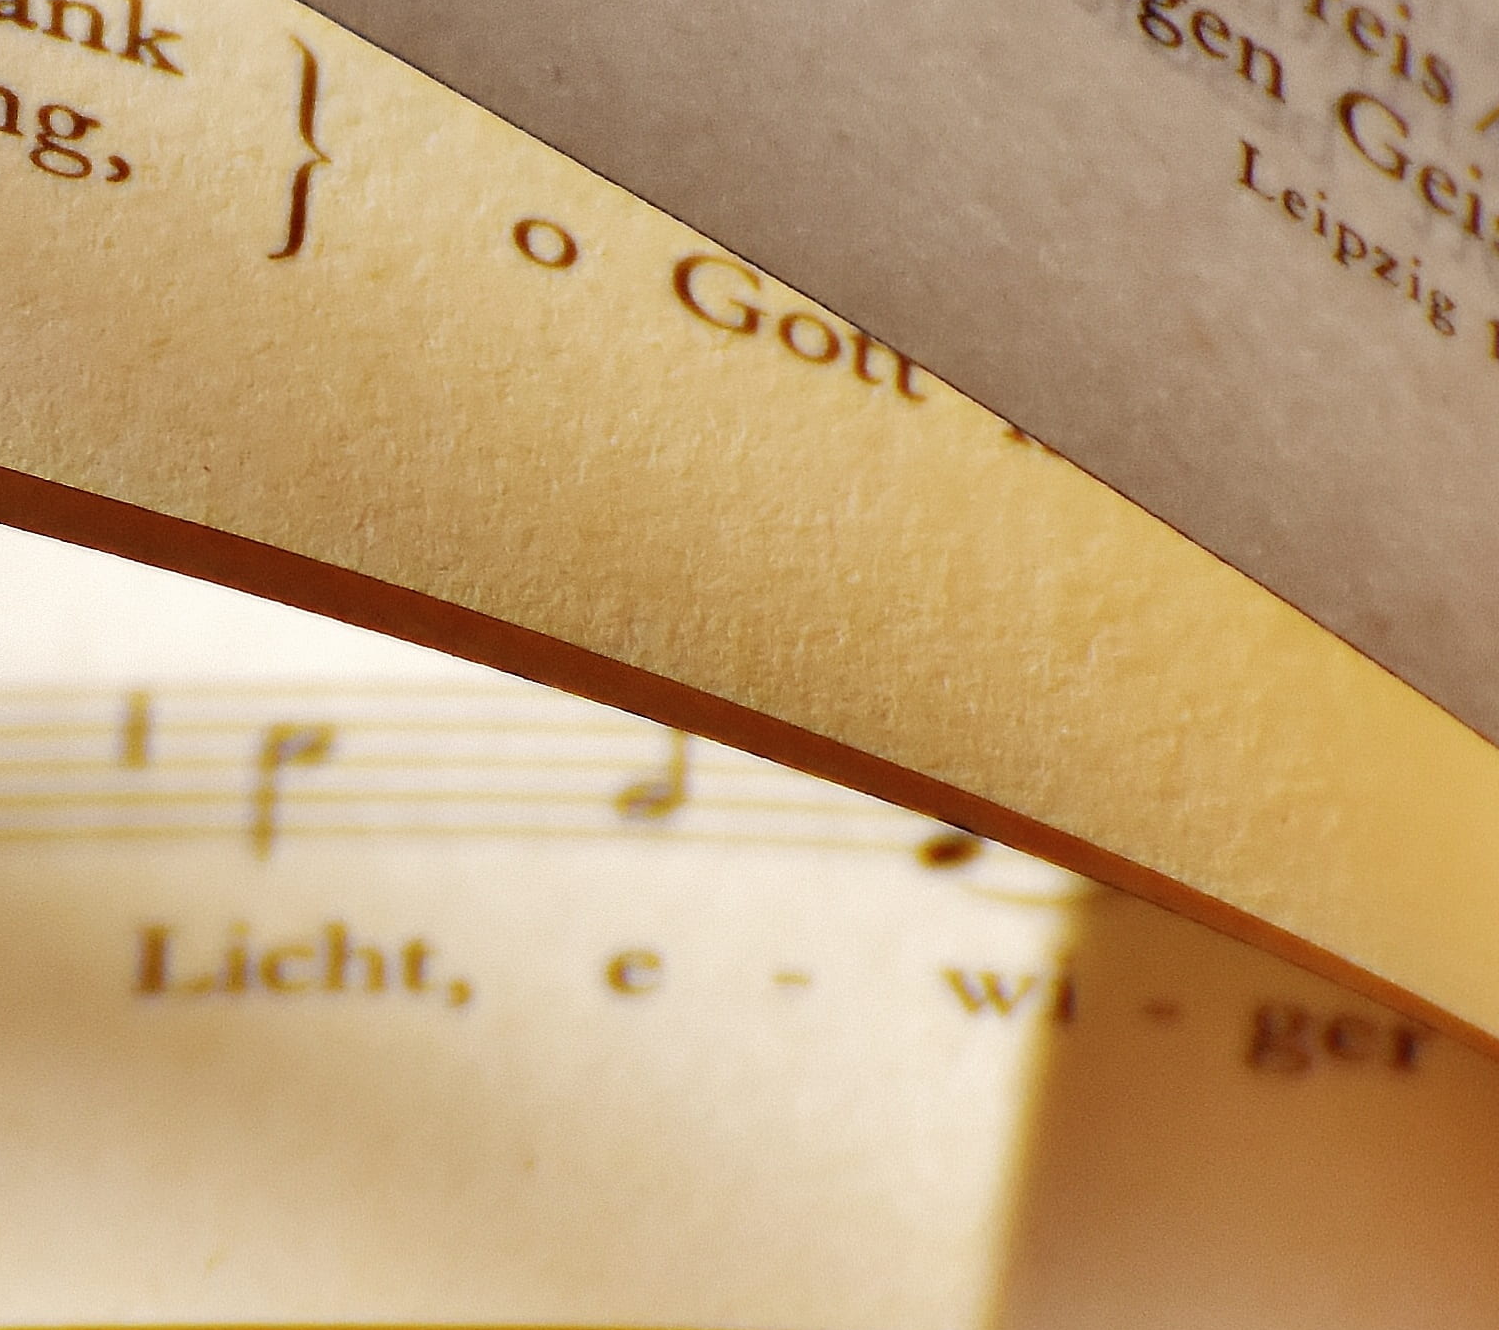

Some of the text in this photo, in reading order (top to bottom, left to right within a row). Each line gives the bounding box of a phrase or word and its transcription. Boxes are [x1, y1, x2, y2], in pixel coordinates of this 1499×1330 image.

[513, 217, 579, 270] o
[1236, 139, 1459, 336] Leipzig
[131, 922, 476, 1010] Licht,
